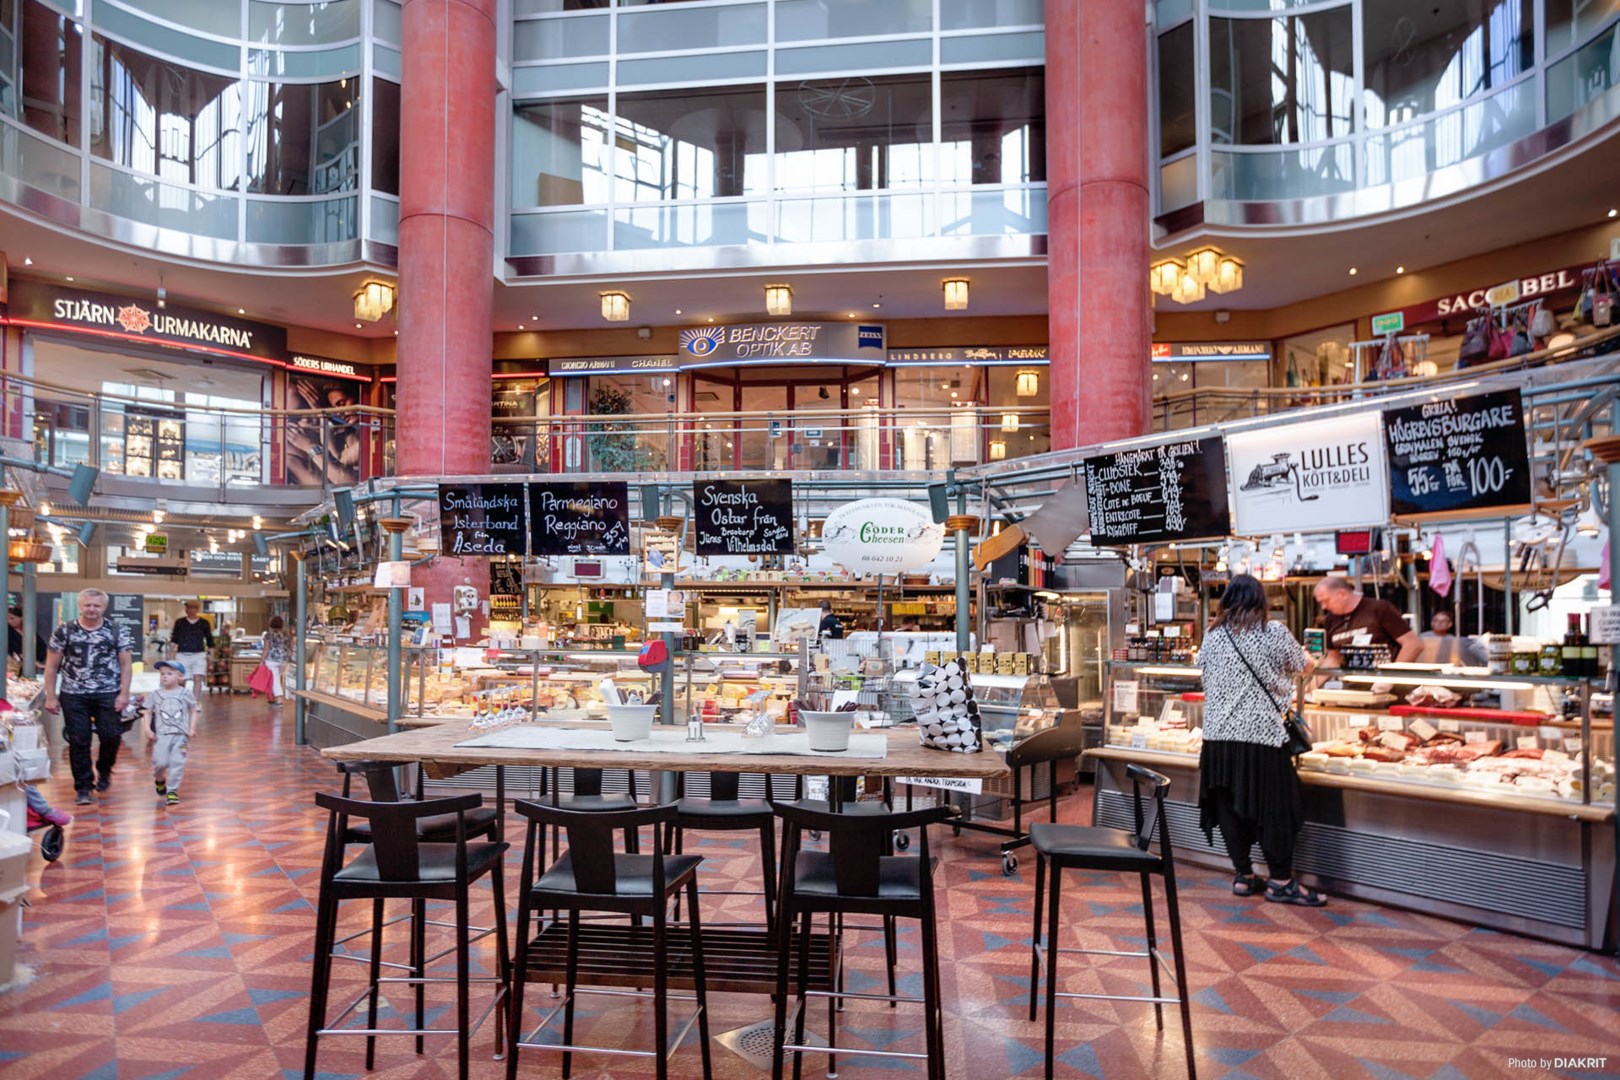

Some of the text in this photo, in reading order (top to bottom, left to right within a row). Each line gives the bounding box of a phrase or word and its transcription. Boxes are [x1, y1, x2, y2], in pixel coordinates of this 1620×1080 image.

[54, 298, 250, 350] STJÄRN URMAKARNA
[728, 325, 821, 342] BENCKERT
[858, 331, 882, 339] ZEISS
[736, 340, 812, 358] OPTIK AB
[890, 352, 953, 361] LINDBERG
[293, 356, 356, 375] SÖDERS URHANDEL
[631, 358, 674, 368] CHANEL
[1301, 442, 1369, 471] LULLES
[1302, 467, 1370, 488] KÖTT&DELI
[541, 491, 618, 517] Parmegiano
[701, 484, 758, 510] Svenska
[544, 515, 607, 540] Reggiano
[711, 505, 778, 530] Ostar från
[452, 531, 507, 554] Åseda
